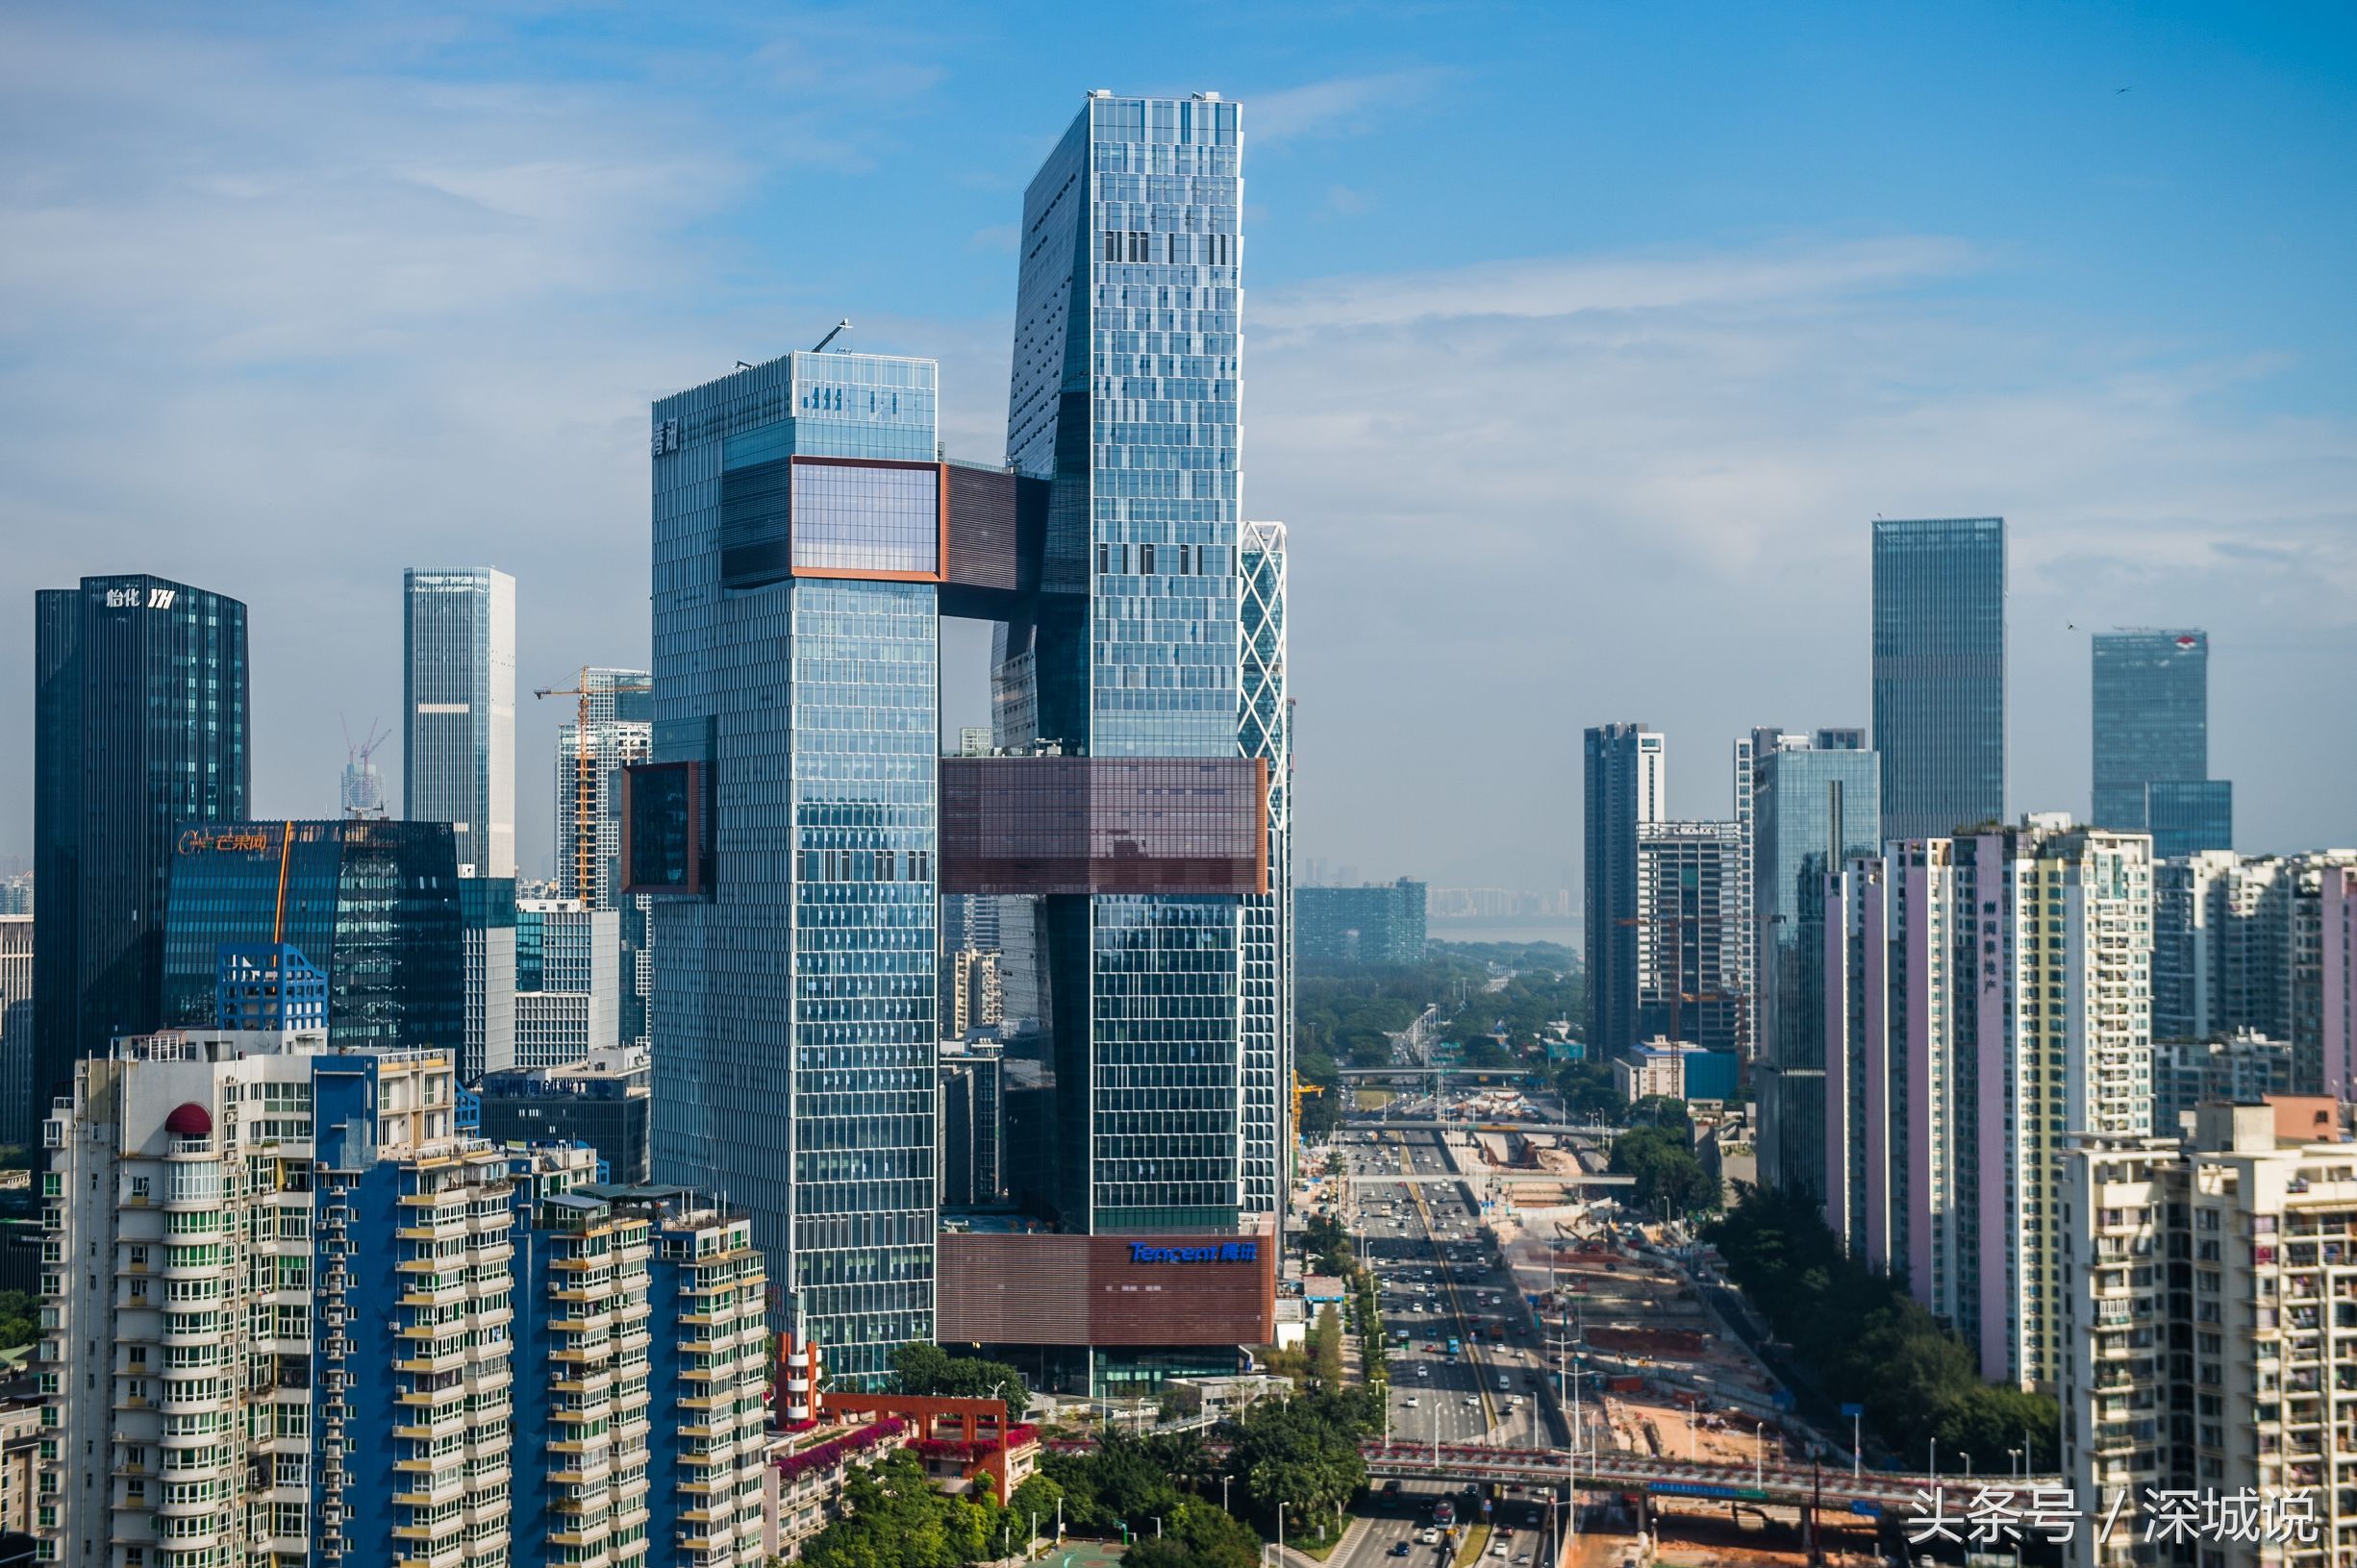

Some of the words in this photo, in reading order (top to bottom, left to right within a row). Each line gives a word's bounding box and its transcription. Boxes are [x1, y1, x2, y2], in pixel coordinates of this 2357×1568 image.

[107, 588, 140, 608] 怡化
[147, 588, 176, 610] YH
[216, 834, 267, 851] 芒果网
[1129, 1241, 1218, 1261] Tencent
[1220, 1241, 1257, 1261] 腾讯
